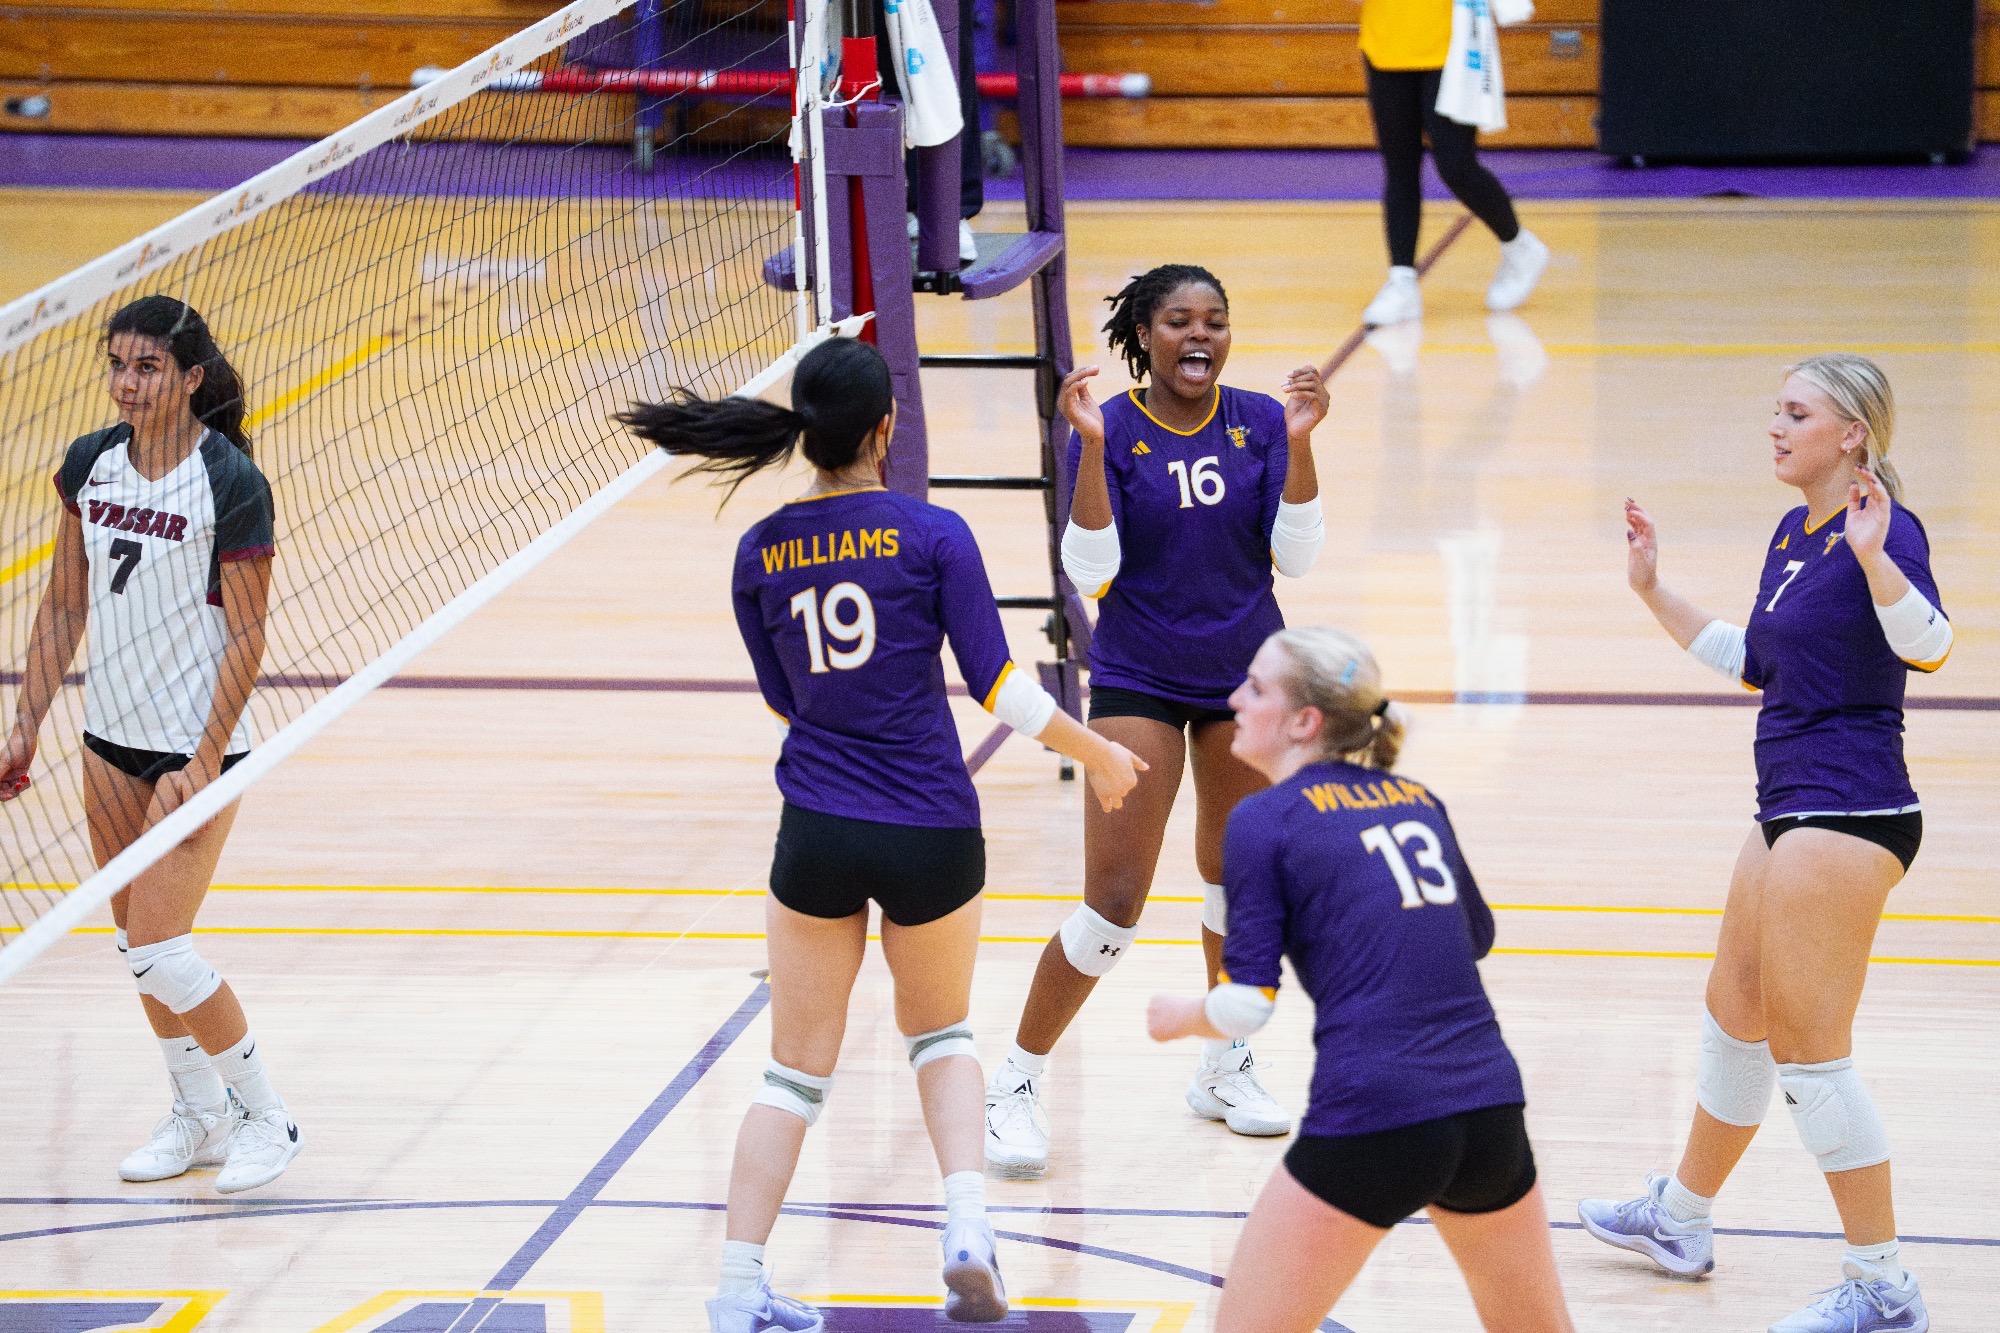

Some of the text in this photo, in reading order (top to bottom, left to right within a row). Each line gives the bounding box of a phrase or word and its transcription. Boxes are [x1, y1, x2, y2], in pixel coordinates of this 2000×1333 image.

[1167, 455, 1226, 509] 16
[88, 499, 188, 542] VASSAR
[108, 537, 143, 595] 7
[761, 527, 900, 575] WILLIAMS
[1764, 559, 1806, 612] 7
[789, 581, 876, 674] 19
[1301, 778, 1436, 814] WILLIAM
[1359, 820, 1457, 909] 13
